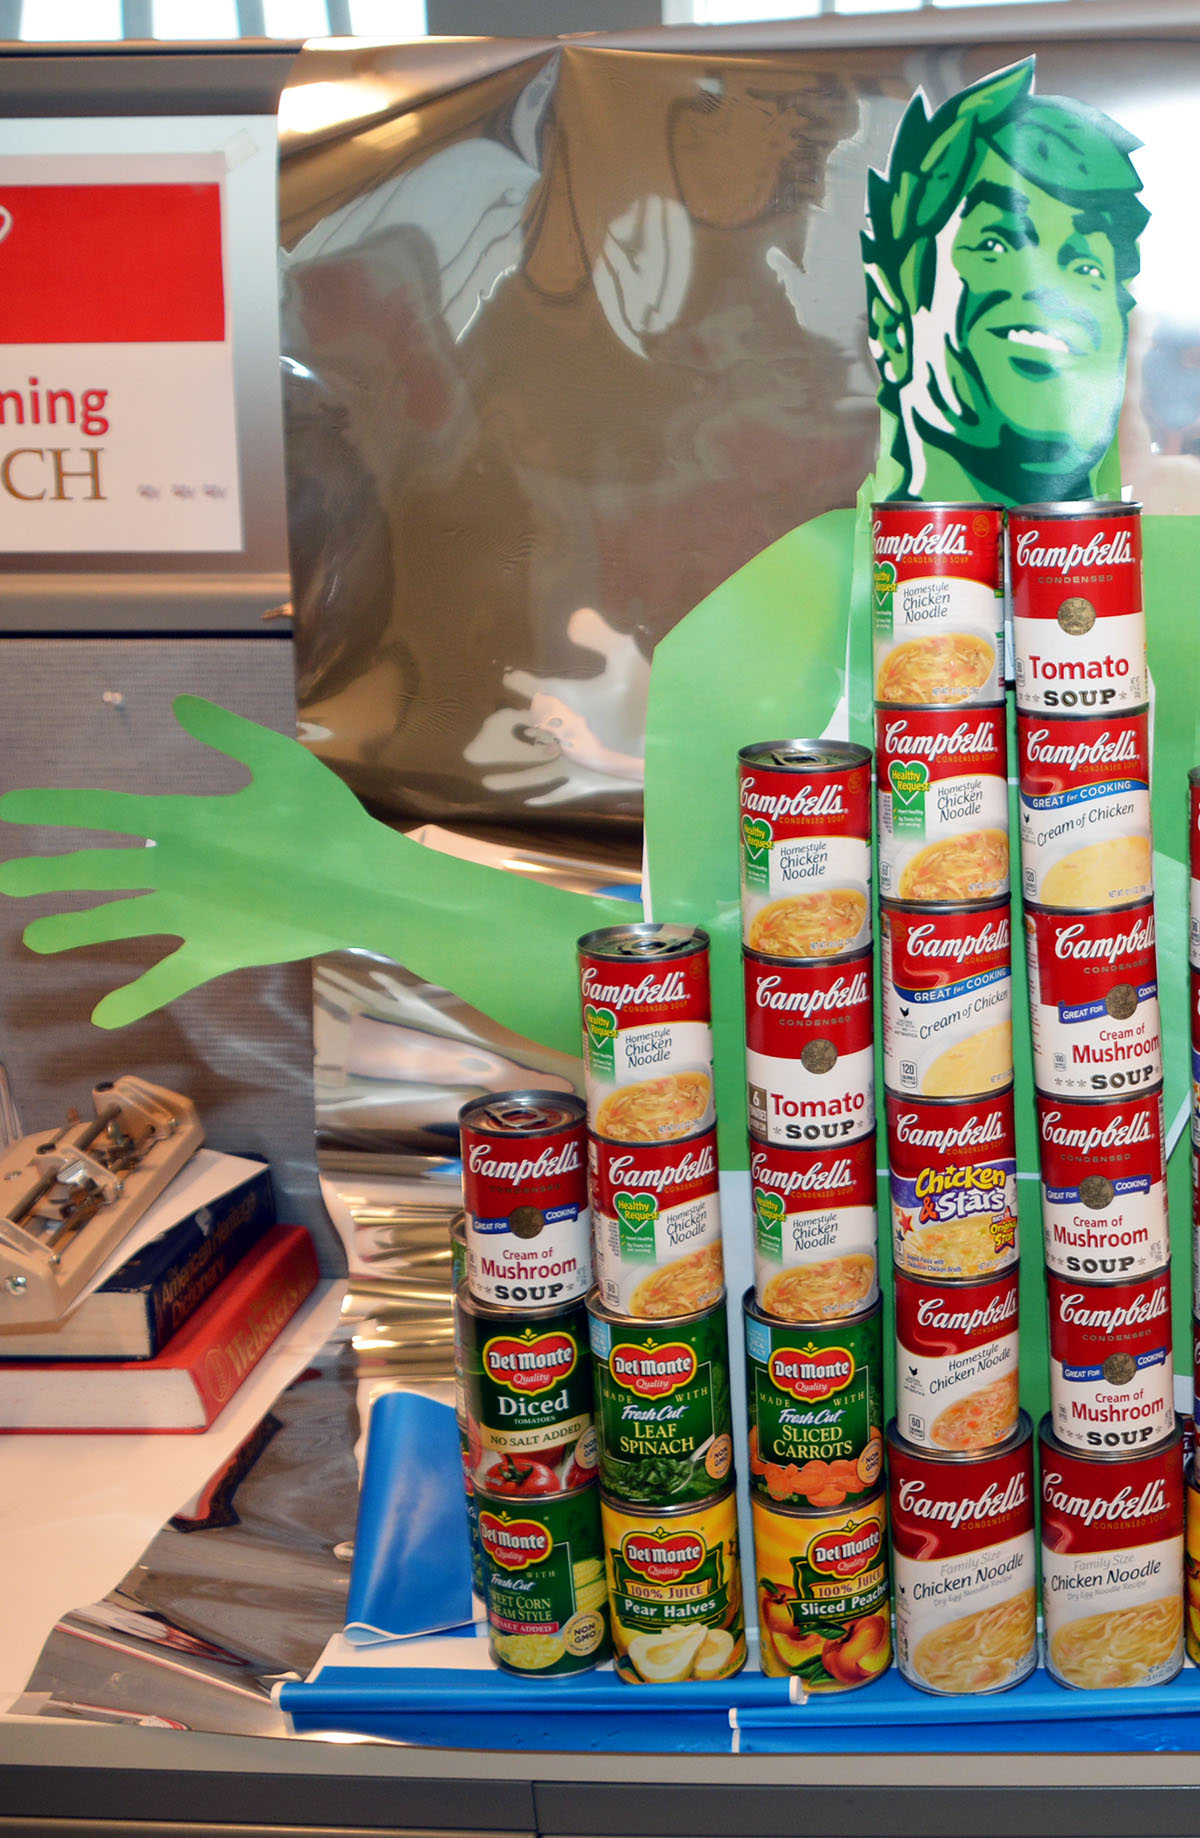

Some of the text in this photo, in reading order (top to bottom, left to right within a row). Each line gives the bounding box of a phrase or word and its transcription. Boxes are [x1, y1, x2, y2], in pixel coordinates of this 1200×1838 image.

[1016, 530, 1132, 575] Campbell's
[903, 582, 949, 598] Homestyle
[905, 607, 948, 624] Noodle
[1029, 655, 1129, 679] Tomato
[1043, 688, 1116, 707] SOUP
[885, 720, 994, 762] Campbell's
[1027, 729, 1137, 771] Campbell's
[740, 777, 844, 821] Campbell's
[937, 780, 982, 797] Homestyle
[1033, 780, 1131, 809] GREAT for COOKING
[939, 803, 981, 823] Noodle
[1037, 818, 1074, 847] Cream
[1076, 814, 1086, 828] of
[1088, 803, 1134, 823] Chicken
[907, 918, 1009, 965] Campbell's
[582, 967, 686, 1010] Campbell's
[756, 972, 868, 1018] Campbell's
[914, 968, 1006, 1001] GREAT for COOKING
[920, 1011, 960, 1039] Cream
[962, 1005, 971, 1019] of
[974, 990, 1008, 1012] Chicken
[1063, 1007, 1088, 1020] GREAT
[1099, 1025, 1145, 1042] Cream of
[628, 1050, 670, 1068] Noodle
[1072, 1036, 1159, 1063] Mushroom
[902, 1063, 914, 1075] 120
[1091, 1065, 1153, 1090] SOUP
[771, 1092, 864, 1117] Tomato
[786, 1120, 855, 1139] SOUP
[896, 1110, 1003, 1153] Campbell's
[1042, 1110, 1152, 1154] Campbell's
[469, 1141, 580, 1186] Campbell's
[609, 1146, 715, 1192] Campbell's
[751, 1153, 853, 1195] Campbell's
[914, 1165, 1006, 1199] Chicken
[618, 1201, 649, 1211] Healthy
[624, 1211, 659, 1220] Request
[919, 1190, 1005, 1223] & Stars
[1073, 1215, 1123, 1228] Cream of
[1054, 1224, 1148, 1248] Mushroom
[1067, 1256, 1135, 1273] SOUP
[918, 1288, 1017, 1335] Campbell's
[1059, 1285, 1168, 1333] Campbell's
[615, 1357, 691, 1375] Del Monte
[774, 1361, 849, 1379] Del Monte
[948, 1344, 999, 1371] Homestyle
[929, 1367, 975, 1395] Chicken
[977, 1347, 1011, 1375] Noodle
[497, 1389, 569, 1416] Diced
[1095, 1388, 1144, 1403] Cream of
[514, 1416, 556, 1425] TOMATOES
[1072, 1397, 1164, 1422] Mushroom
[490, 1423, 581, 1446] NO SALT ADDED
[634, 1421, 676, 1438] LEAF
[783, 1425, 842, 1442] SLICED
[1087, 1426, 1154, 1446] SOUP
[620, 1436, 694, 1455] SPINACH
[773, 1440, 852, 1459] CARROTS
[899, 1471, 1026, 1529] Campbell's
[1043, 1470, 1166, 1526] Campbell's
[815, 1530, 879, 1561] Del Monte
[940, 1551, 1001, 1577] Family Size
[1073, 1554, 1134, 1571] Family Size
[819, 1569, 882, 1597] 100% JUICE
[913, 1553, 1024, 1600] Chicken Noodle
[1051, 1559, 1161, 1592] Chicken Noodle
[631, 1584, 702, 1599] 100% JUICE
[624, 1599, 716, 1617] Pear Halves
[574, 1624, 596, 1636] NON
[575, 1631, 596, 1644] GMO
